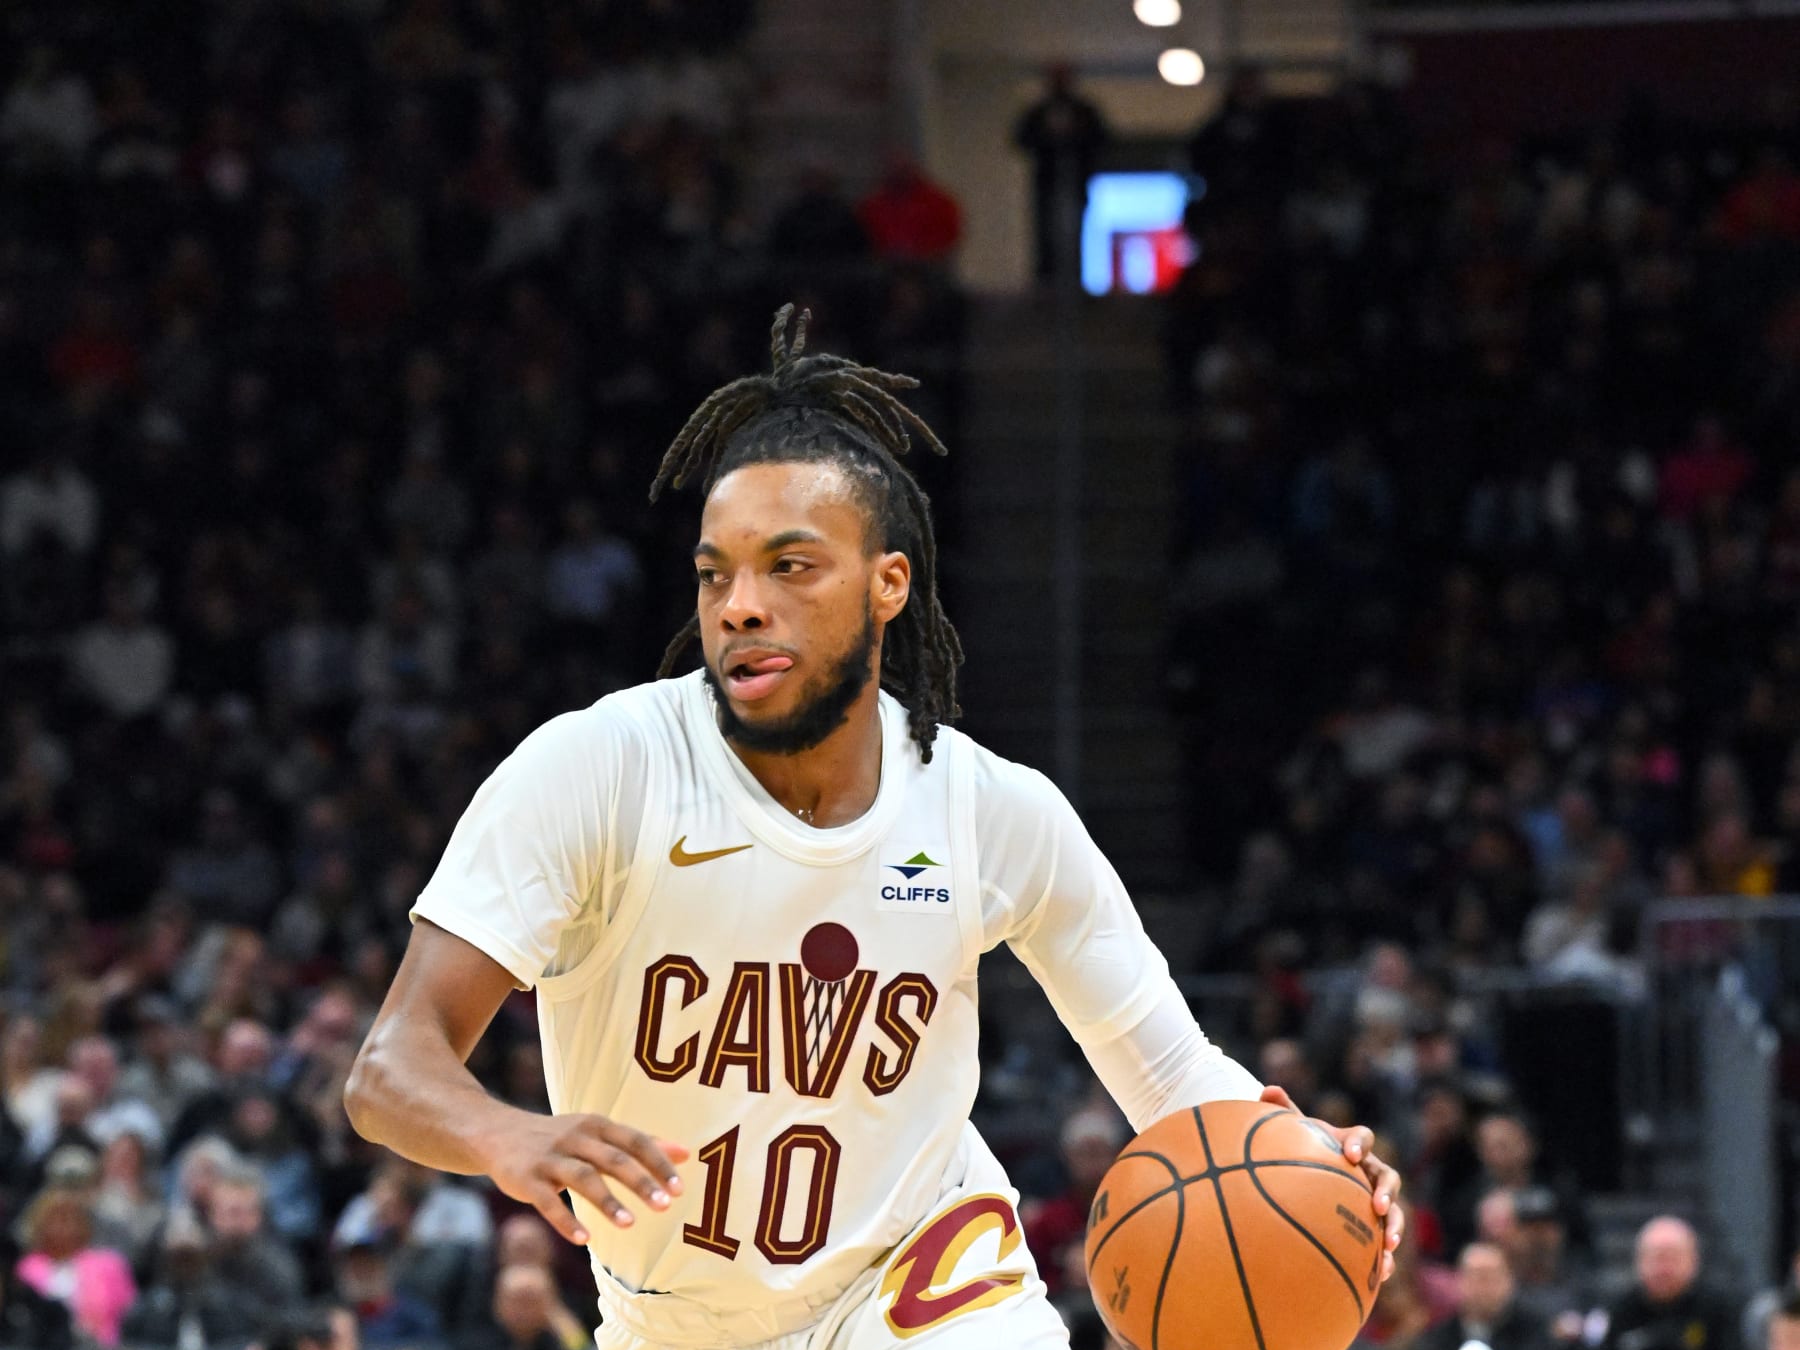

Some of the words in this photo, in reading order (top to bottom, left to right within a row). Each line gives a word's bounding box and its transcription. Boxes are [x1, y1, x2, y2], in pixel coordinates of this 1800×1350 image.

[881, 885, 950, 903] CLIFFS
[634, 953, 939, 1099] CAVS
[682, 1123, 842, 1265] 10
